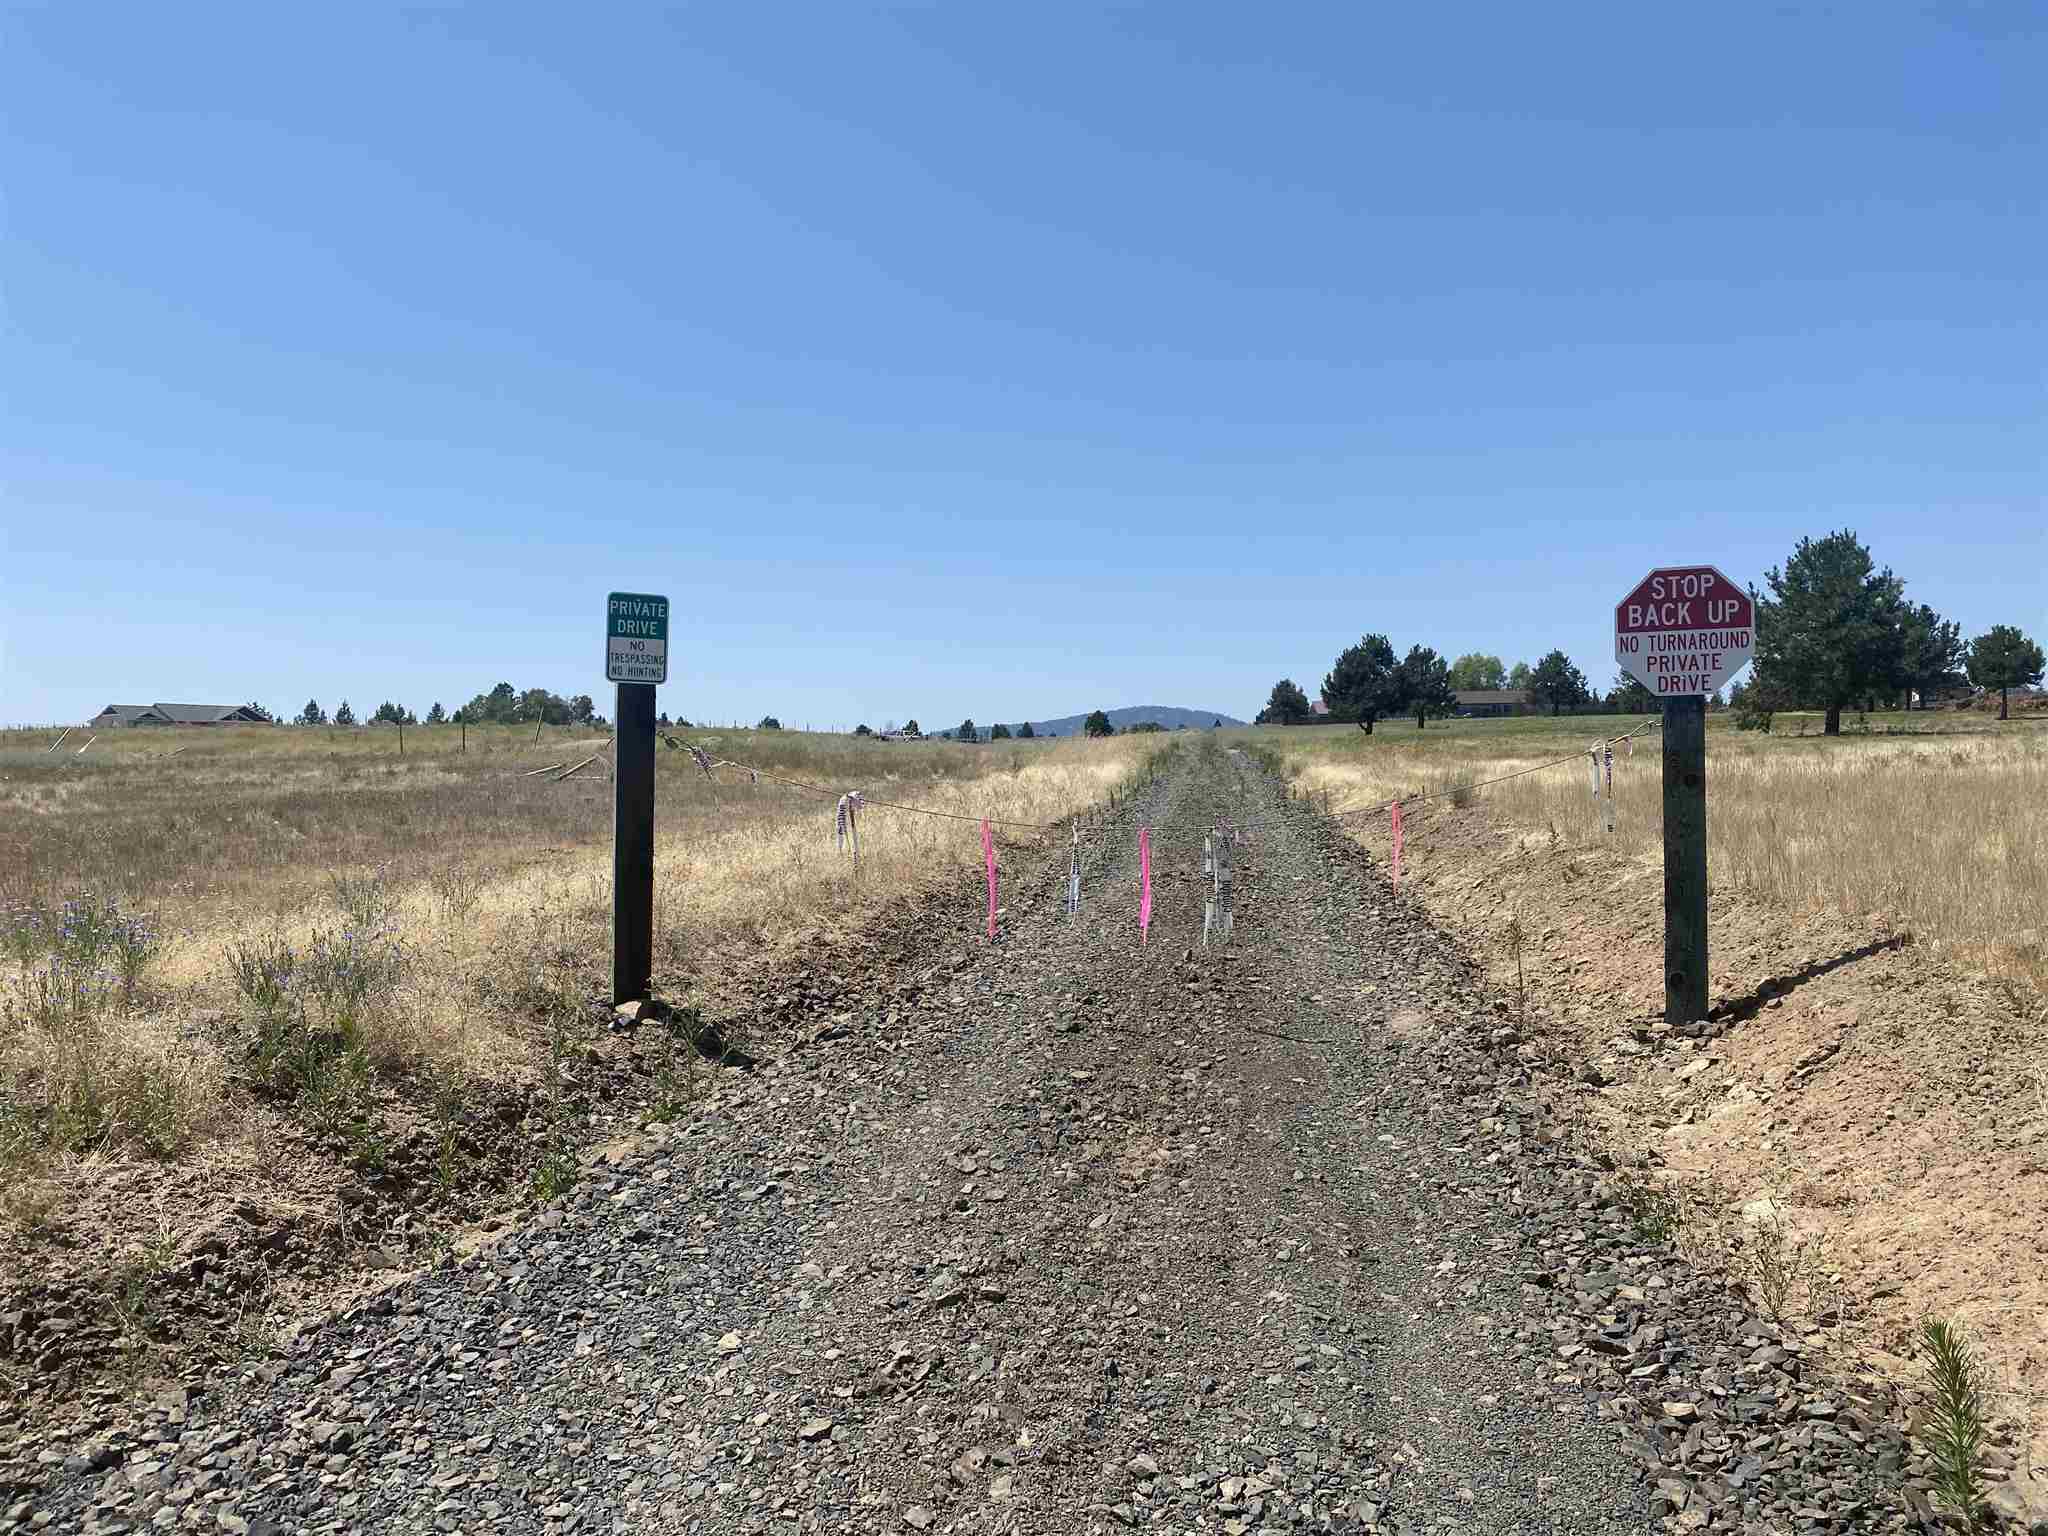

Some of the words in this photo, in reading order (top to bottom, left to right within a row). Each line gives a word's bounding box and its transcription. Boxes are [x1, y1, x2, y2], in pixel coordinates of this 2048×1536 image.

[1651, 574, 1714, 599] STOP
[610, 600, 665, 617] PRIVATE
[1628, 602, 1692, 628] BACK
[1708, 599, 1740, 624] UP
[618, 619, 657, 635] DRIVE
[630, 640, 645, 651] NO
[1619, 635, 1639, 653] NO
[1648, 631, 1750, 652] TURNAROUND
[610, 653, 664, 665] TRESPASSING
[1647, 653, 1722, 673] PRIVATE
[611, 665, 623, 676] NO
[627, 666, 664, 680] HUNTING
[1658, 674, 1712, 693] DRIVE
